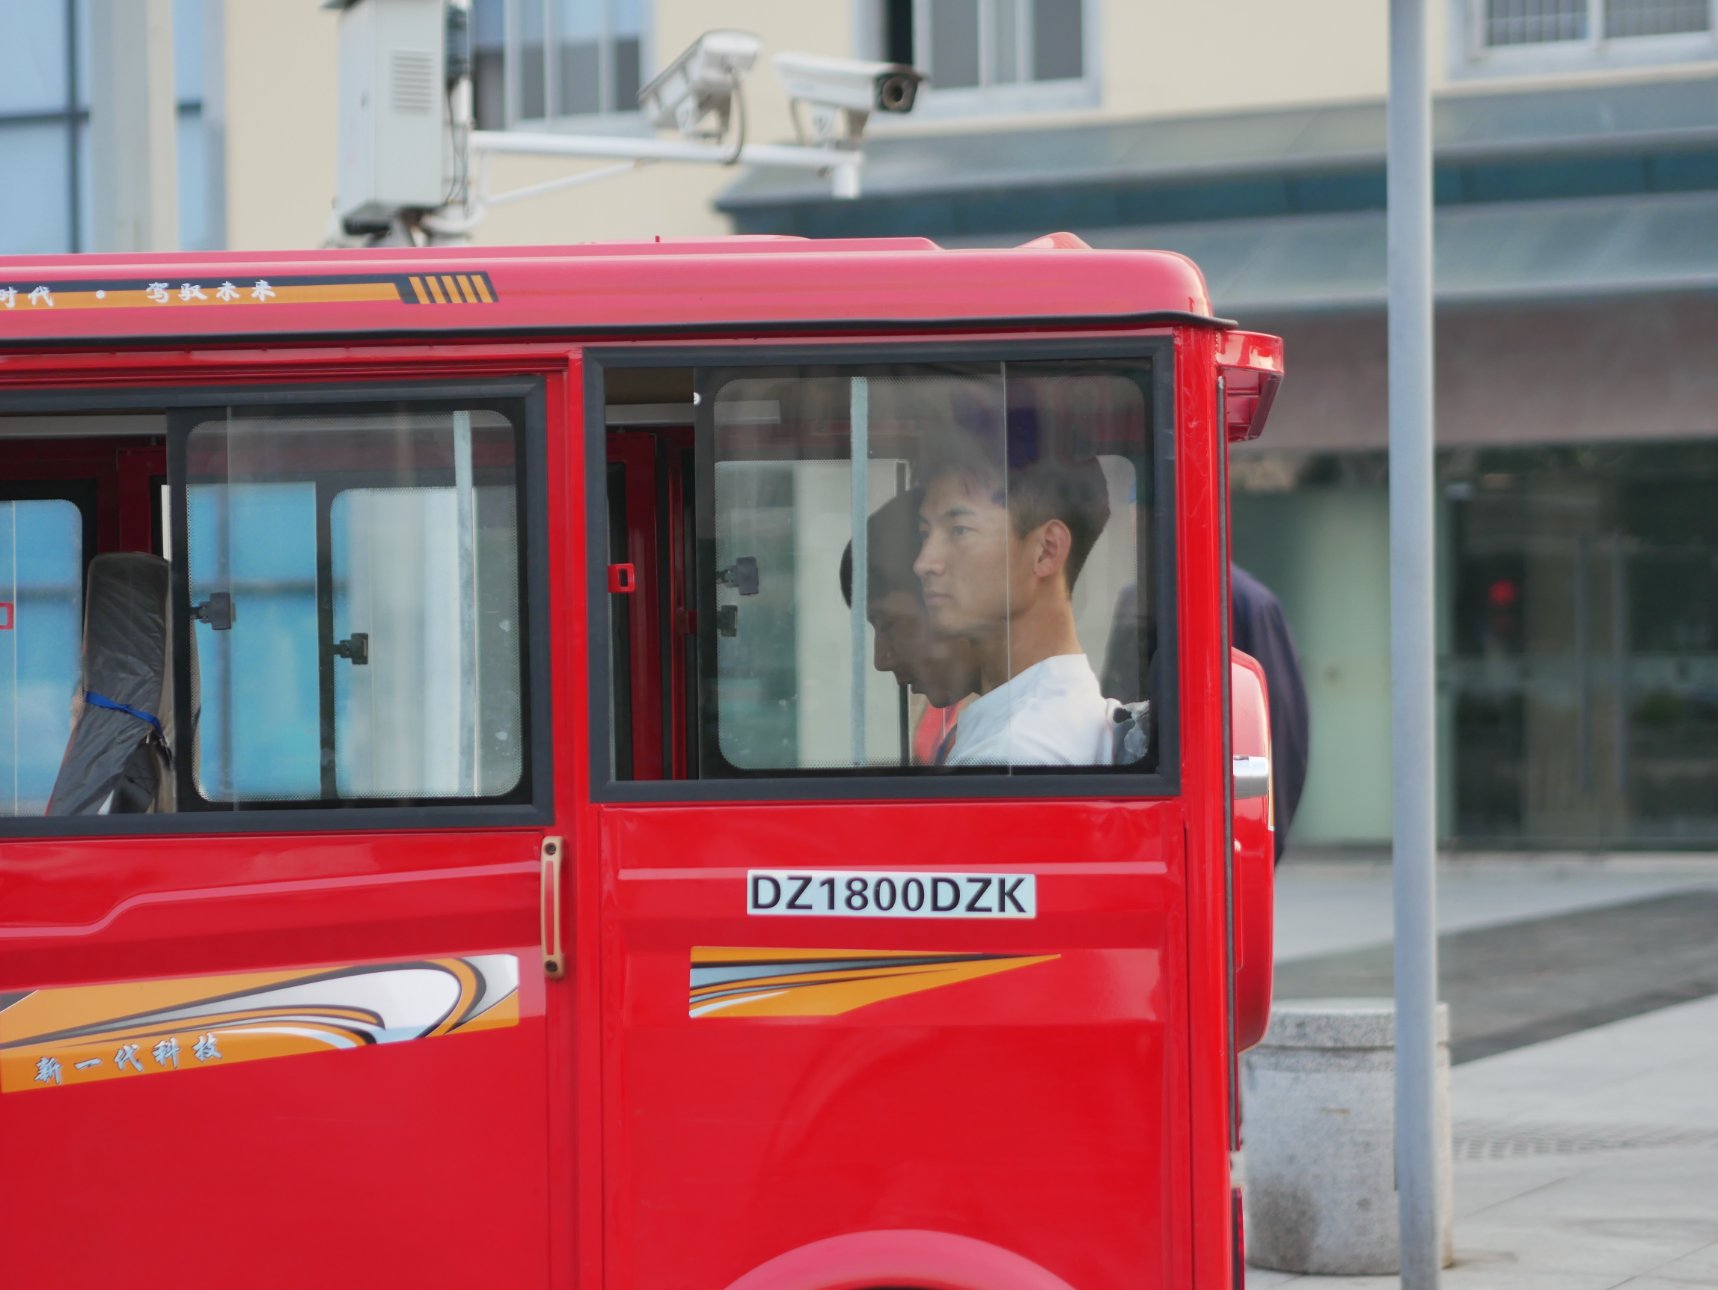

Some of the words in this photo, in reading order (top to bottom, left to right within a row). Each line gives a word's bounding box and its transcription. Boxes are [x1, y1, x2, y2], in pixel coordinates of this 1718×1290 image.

[146, 280, 276, 303] 驾驭未来
[751, 874, 1027, 913] DZ1800DZK
[34, 1032, 222, 1085] 新一代科技
